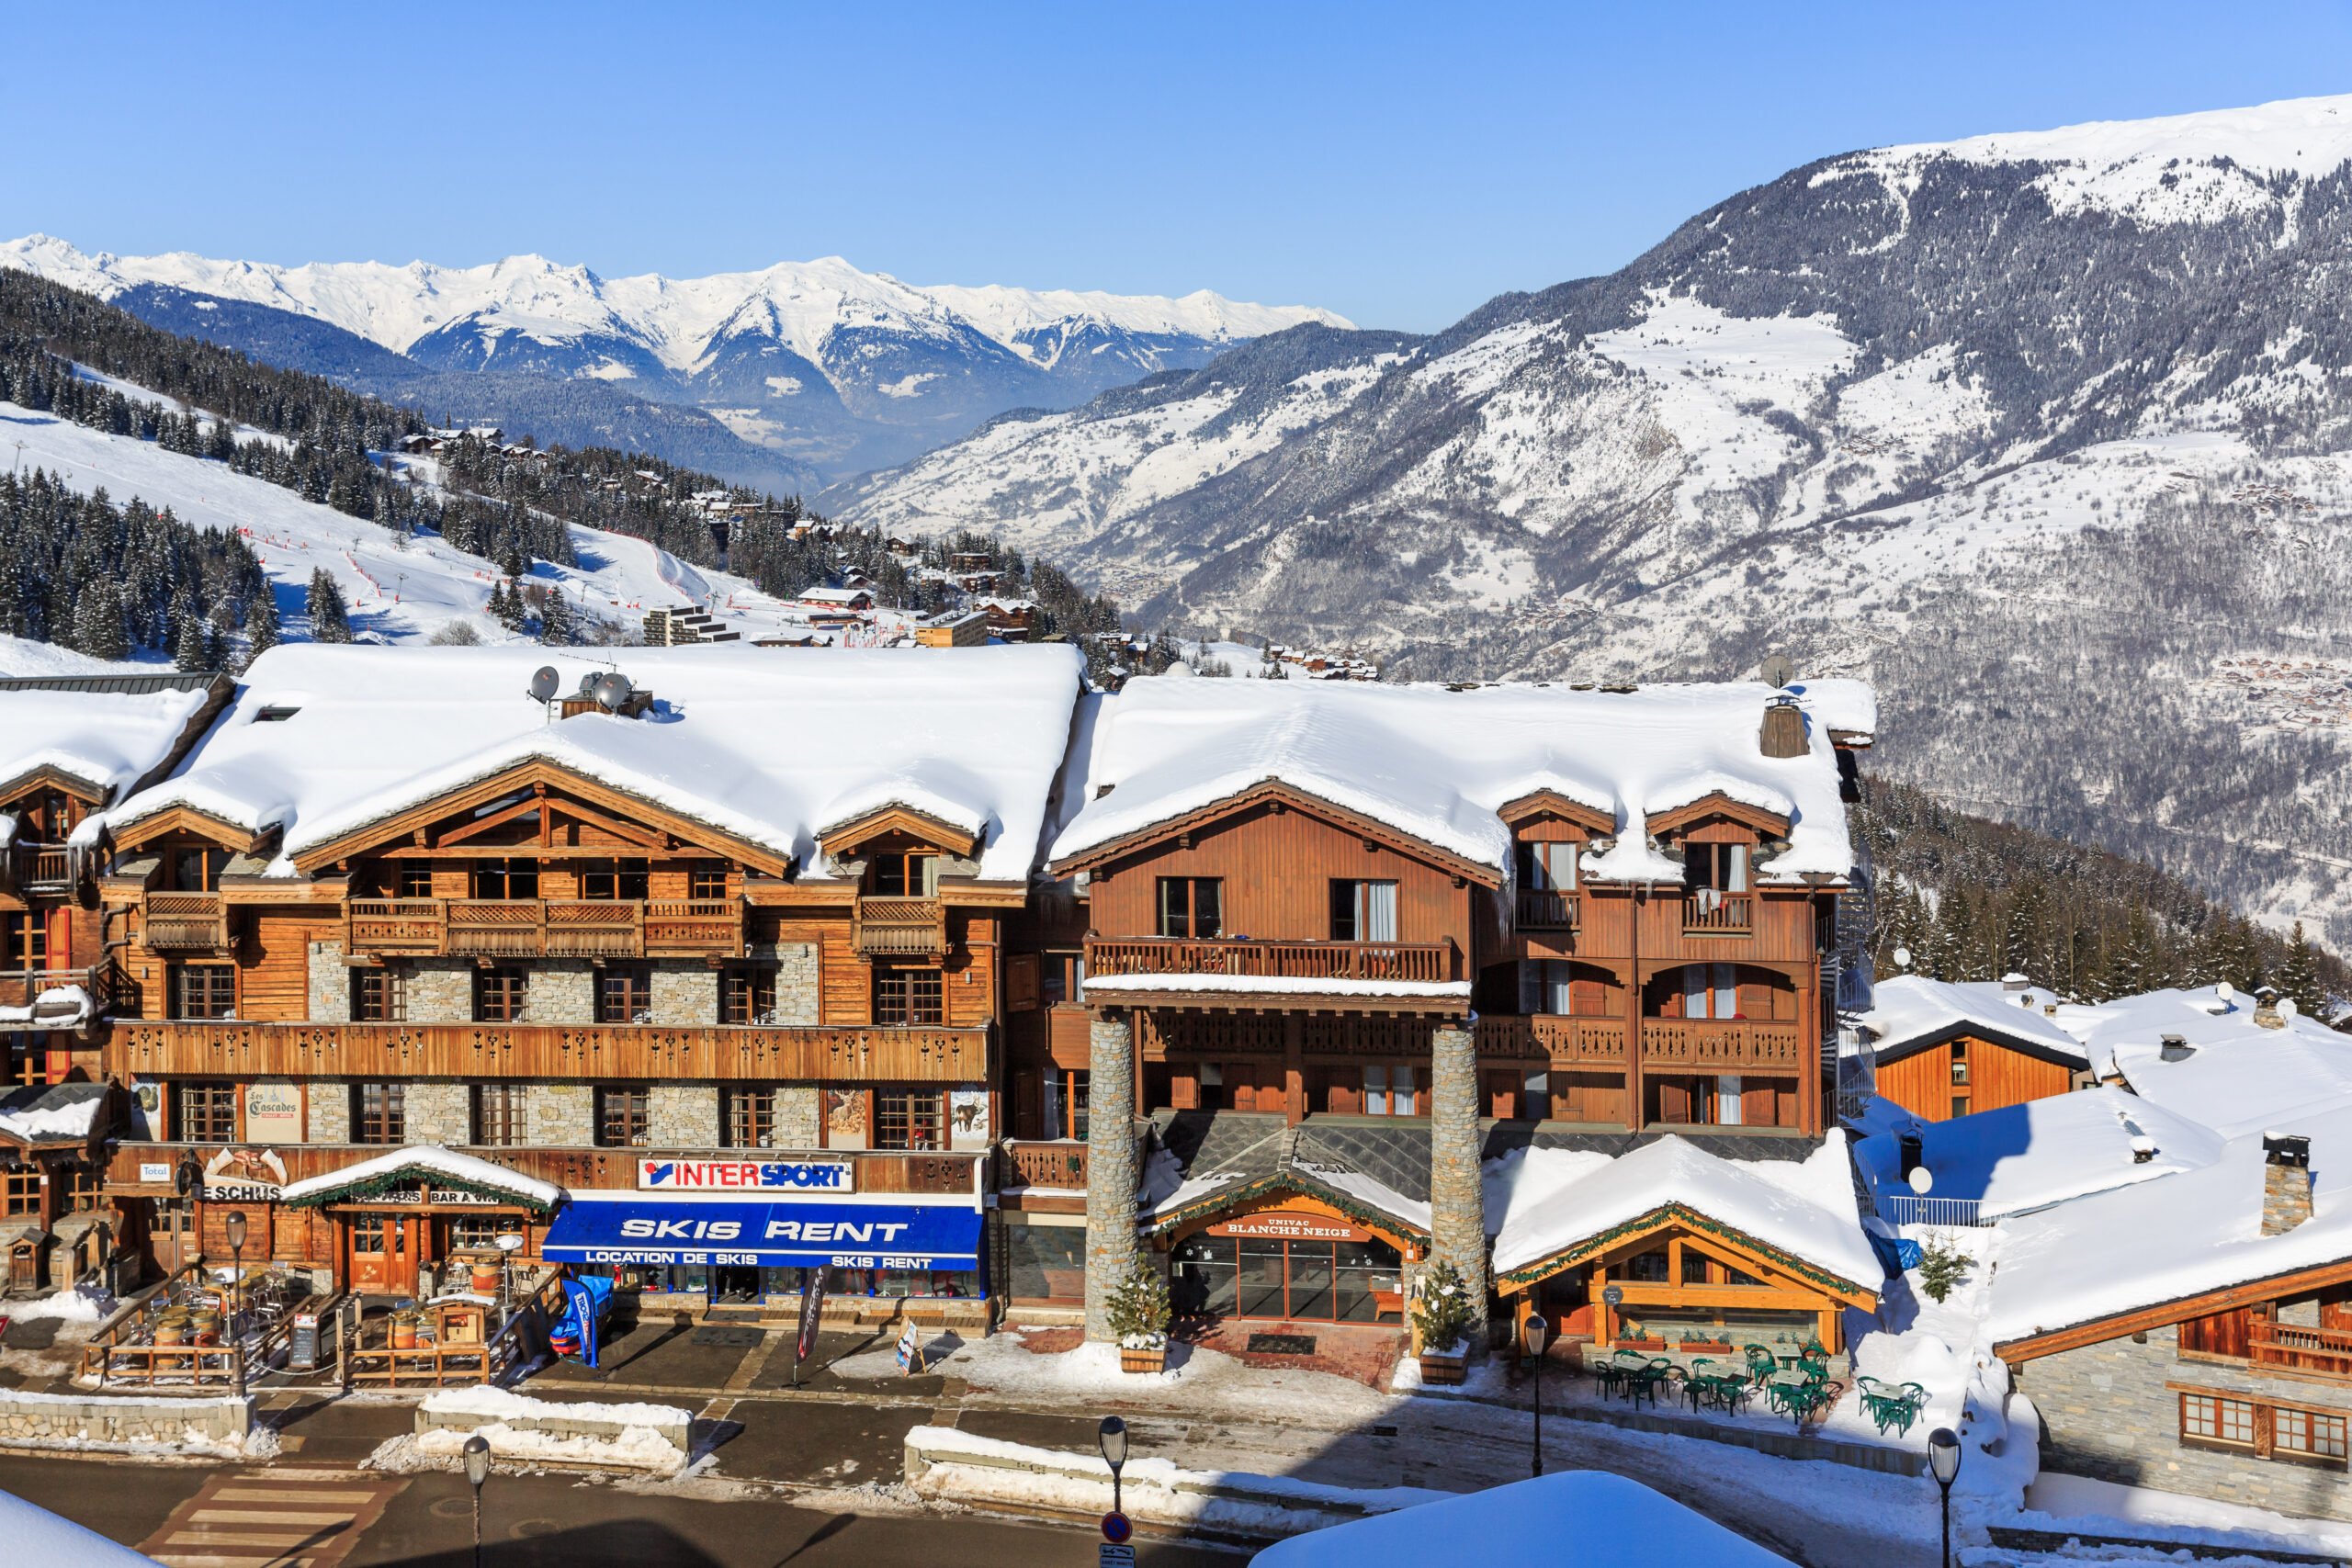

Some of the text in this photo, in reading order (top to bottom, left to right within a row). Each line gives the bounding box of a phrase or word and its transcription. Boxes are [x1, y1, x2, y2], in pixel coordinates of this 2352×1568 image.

[249, 1100, 297, 1118] Cascades
[143, 1167, 167, 1176] Total
[675, 1163, 844, 1187] INTERSPORT
[203, 1187, 212, 1200] E
[431, 1193, 458, 1202] BAR
[620, 1219, 909, 1242] SKIS RENT
[1227, 1224, 1351, 1237] BLANCHE NEIGE
[585, 1251, 758, 1265] LOCATION DE SKIS
[831, 1256, 933, 1269] SKIS RENT
